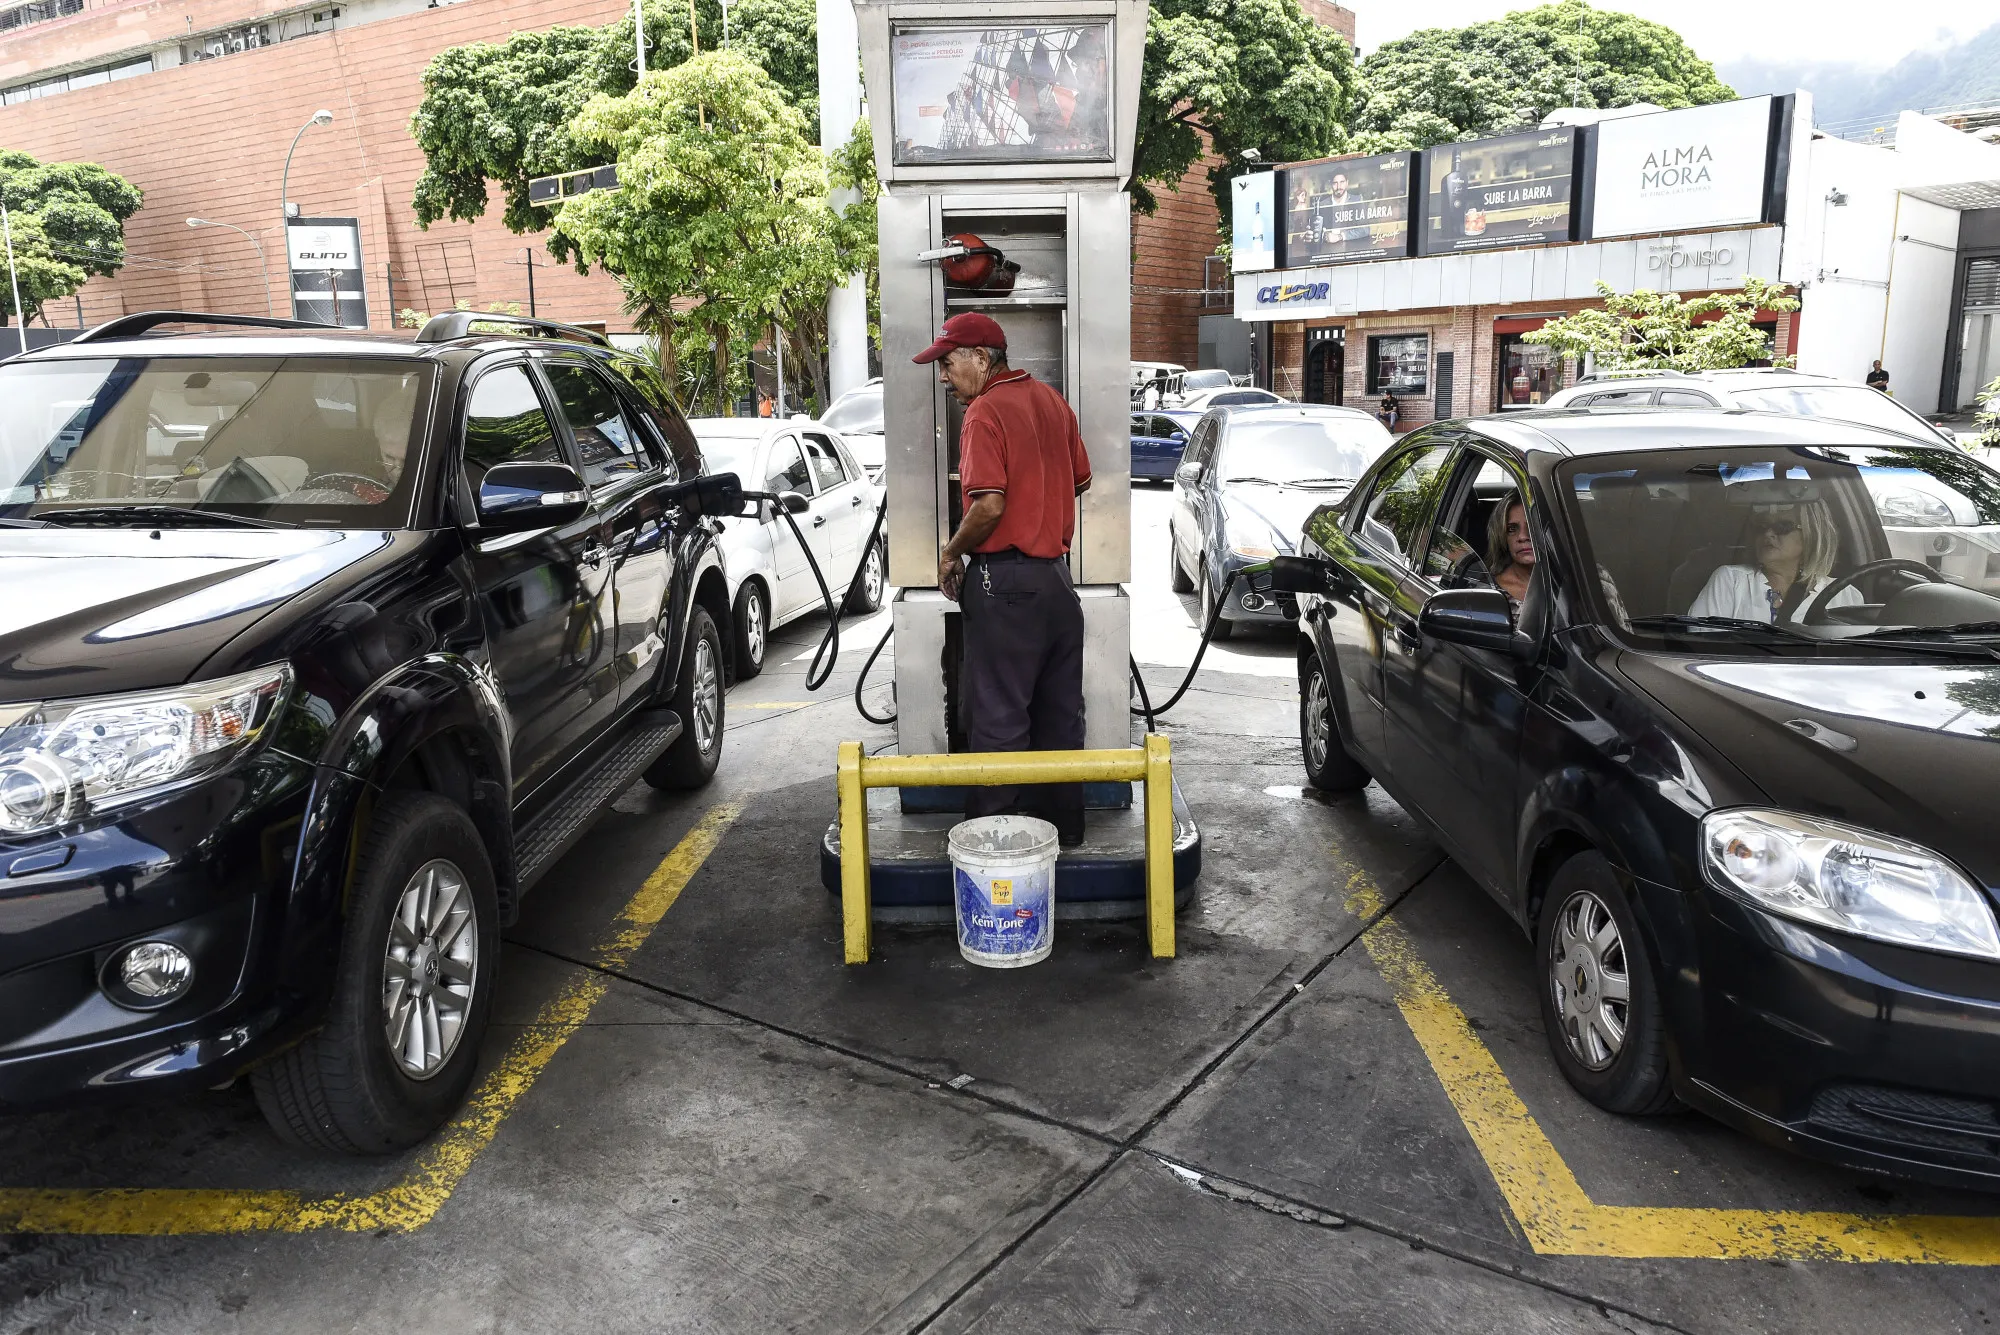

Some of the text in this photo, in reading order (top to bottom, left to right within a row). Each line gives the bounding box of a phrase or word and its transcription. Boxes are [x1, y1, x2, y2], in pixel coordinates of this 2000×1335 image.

[1642, 144, 1713, 170] ALMA
[1641, 165, 1712, 190] MORA
[1484, 185, 1553, 205] SUBE LA BARRA
[1334, 205, 1393, 223] SUBE LA BARRA
[1647, 247, 1733, 271] DIONISIO
[972, 913, 1024, 929] Kem Tone
